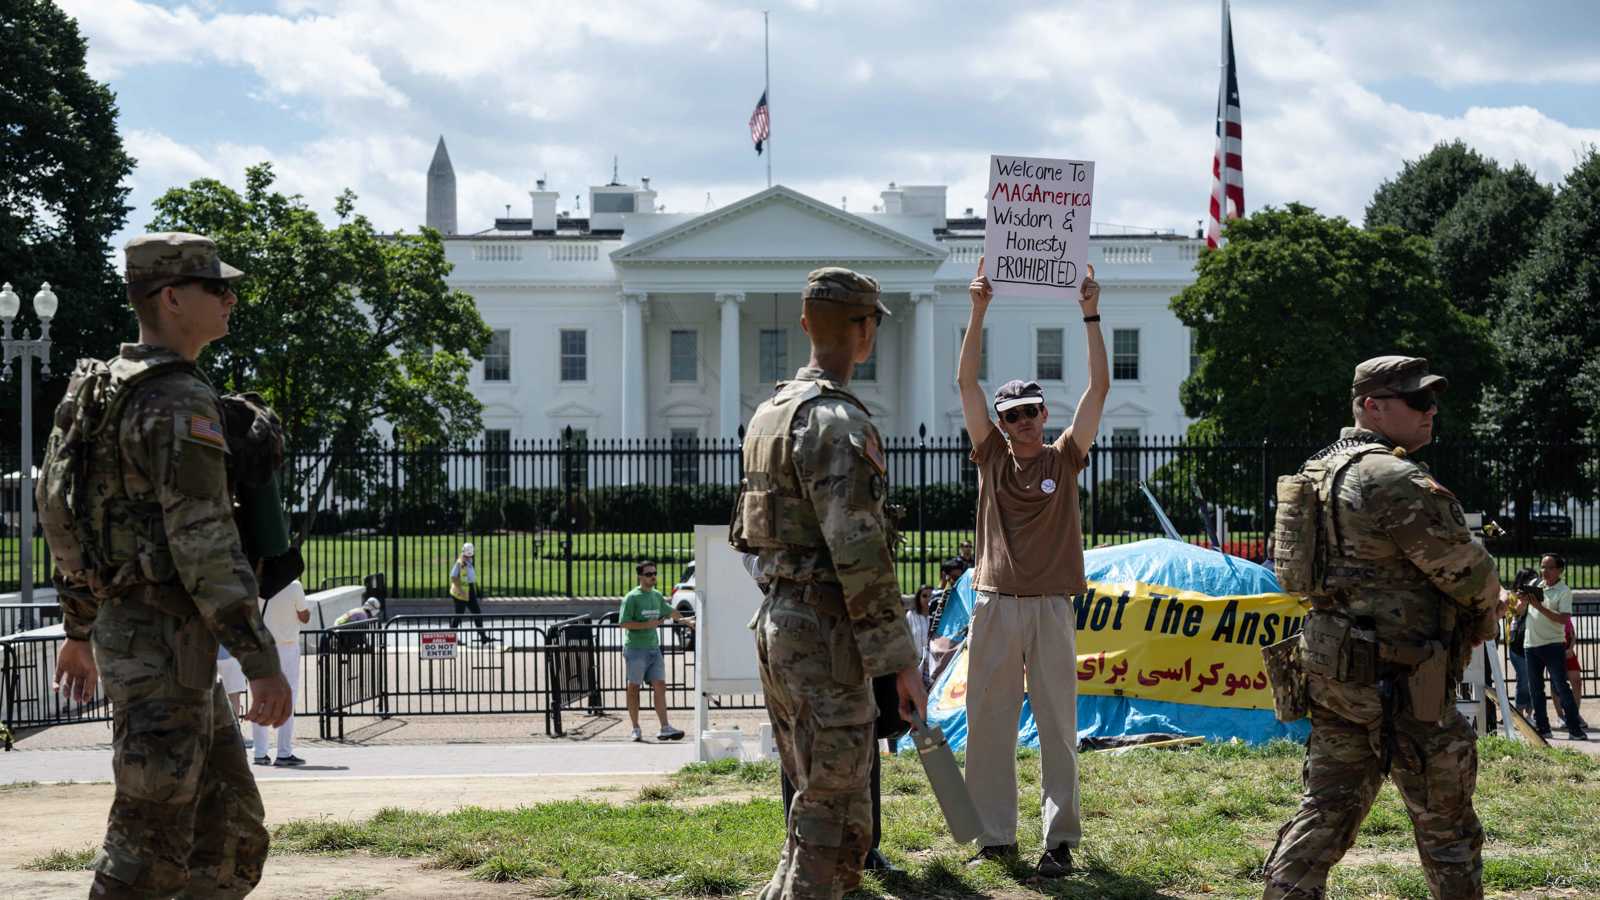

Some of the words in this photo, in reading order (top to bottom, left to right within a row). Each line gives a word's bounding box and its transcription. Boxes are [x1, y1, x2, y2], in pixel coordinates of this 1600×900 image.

[997, 158, 1062, 181] Welcome
[1069, 163, 1086, 182] To
[992, 183, 1091, 206] MAGAmerica
[993, 206, 1053, 229] Wisdom
[1062, 208, 1075, 232] &
[1006, 230, 1067, 260] Honesty
[996, 255, 1077, 286] PROHIBITED
[1073, 587, 1130, 632] Not
[1144, 592, 1204, 637] The
[1077, 649, 1129, 684] برای
